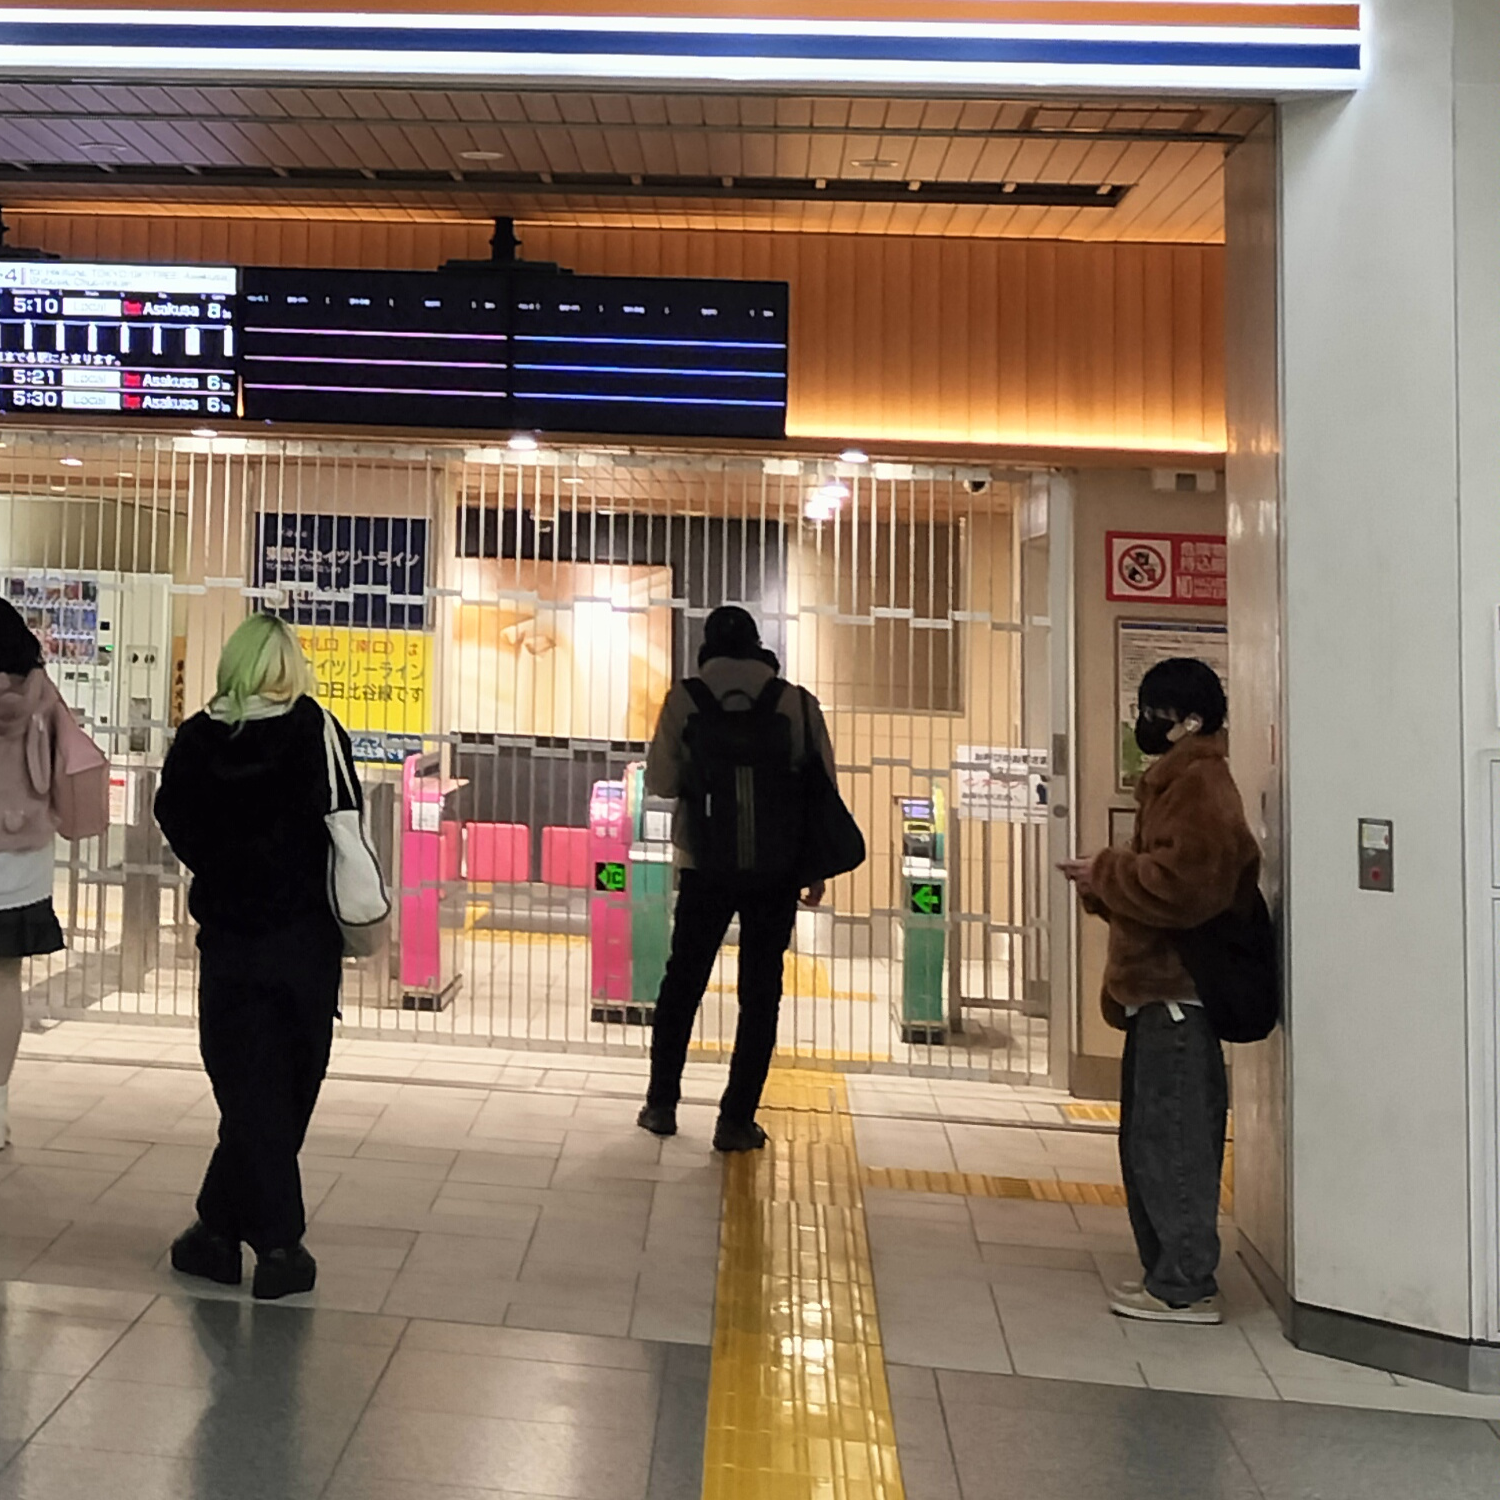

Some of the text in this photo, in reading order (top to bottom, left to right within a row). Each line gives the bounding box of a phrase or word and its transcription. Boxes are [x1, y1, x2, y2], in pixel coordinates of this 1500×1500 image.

[13, 297, 59, 313] 5:10
[142, 301, 200, 318] Asakusa
[12, 369, 55, 385] 5:21
[72, 372, 107, 384] Local
[142, 373, 200, 389] Asakusa
[12, 390, 58, 407] 5:30
[72, 394, 107, 406] Local
[141, 395, 200, 411] Asakusa
[305, 659, 424, 681] イツリーライン
